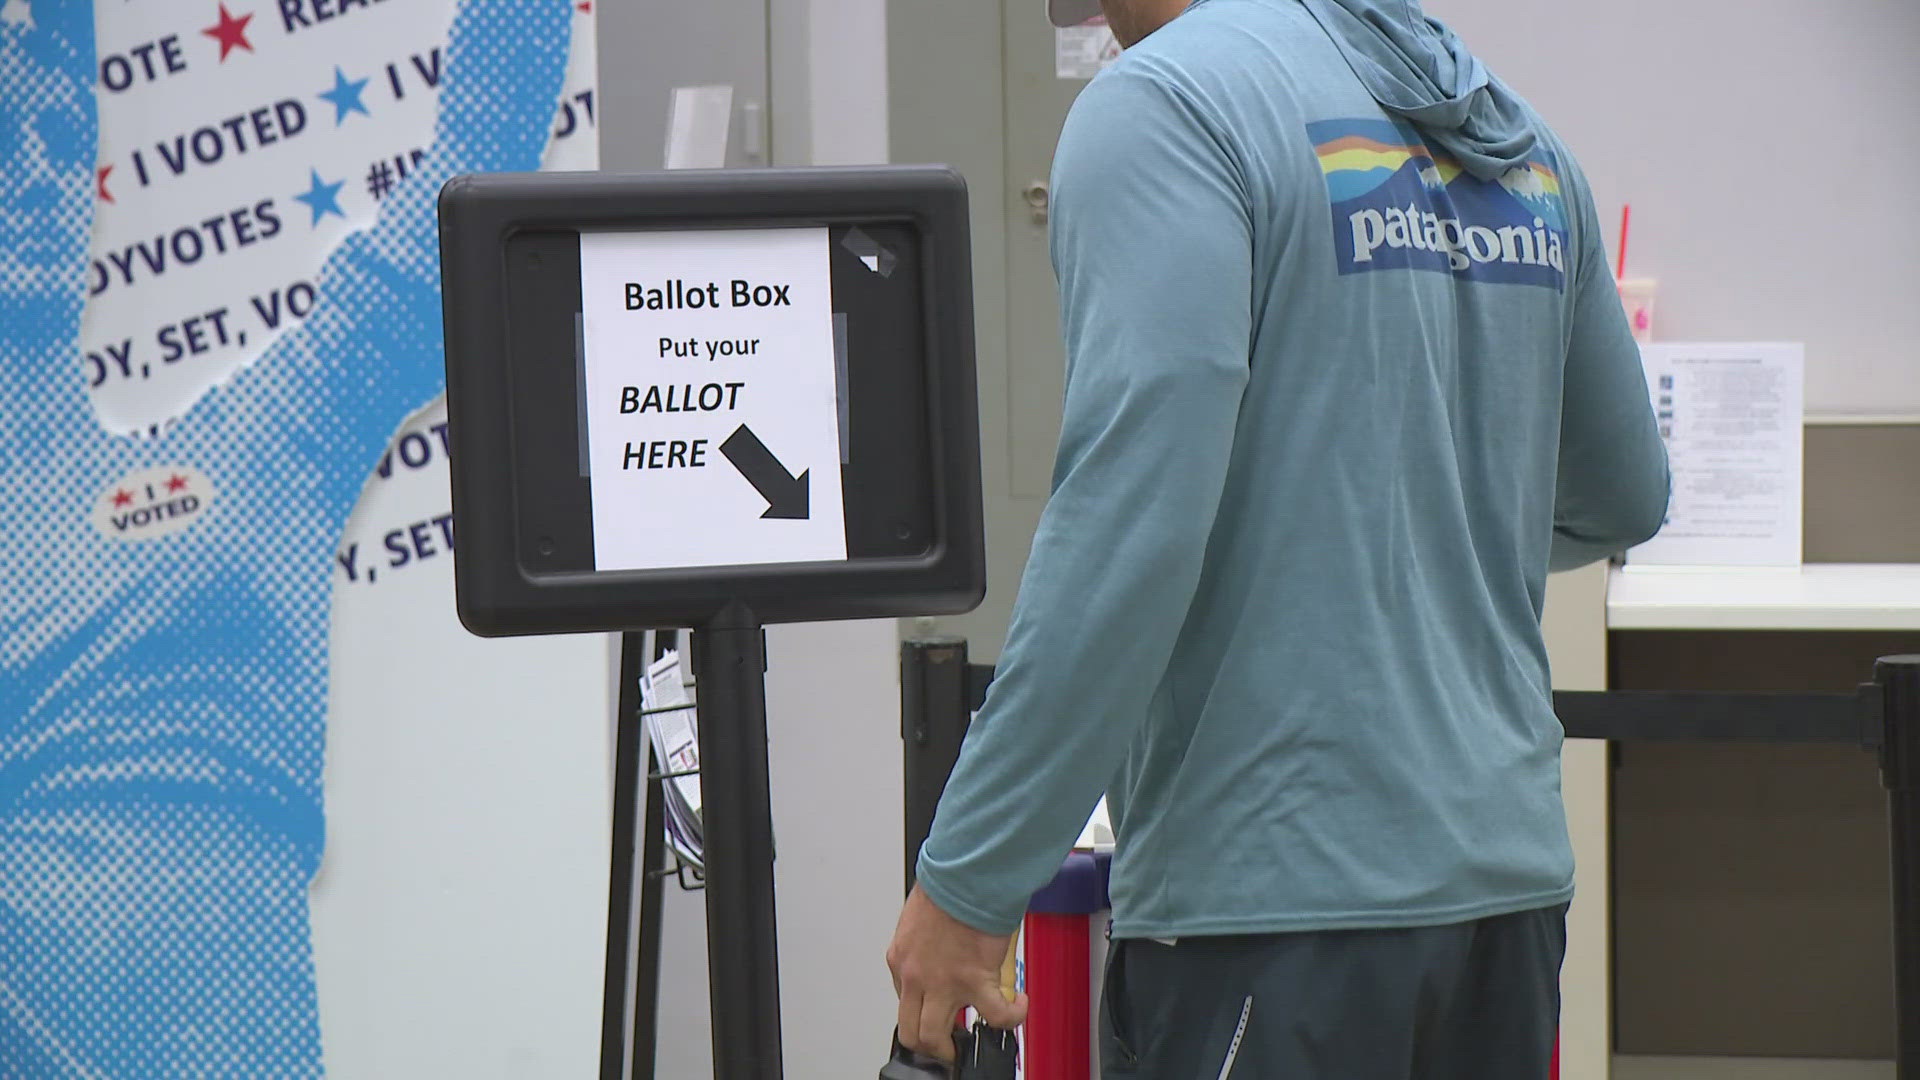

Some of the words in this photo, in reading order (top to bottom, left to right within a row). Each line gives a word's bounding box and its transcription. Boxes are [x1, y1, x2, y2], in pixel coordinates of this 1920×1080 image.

[279, 0, 386, 34] RE
[131, 150, 150, 187] I
[156, 98, 308, 177] VOTED
[386, 62, 406, 101] I
[1349, 201, 1564, 272] patagonia
[624, 279, 720, 311] Ballot
[730, 279, 791, 307] Box
[157, 307, 247, 364] SET,
[659, 337, 699, 358] Put
[705, 338, 760, 361] your
[619, 382, 745, 415] BALLOT
[622, 439, 708, 470] HERE
[145, 482, 156, 501] I
[111, 494, 200, 532] VOTED
